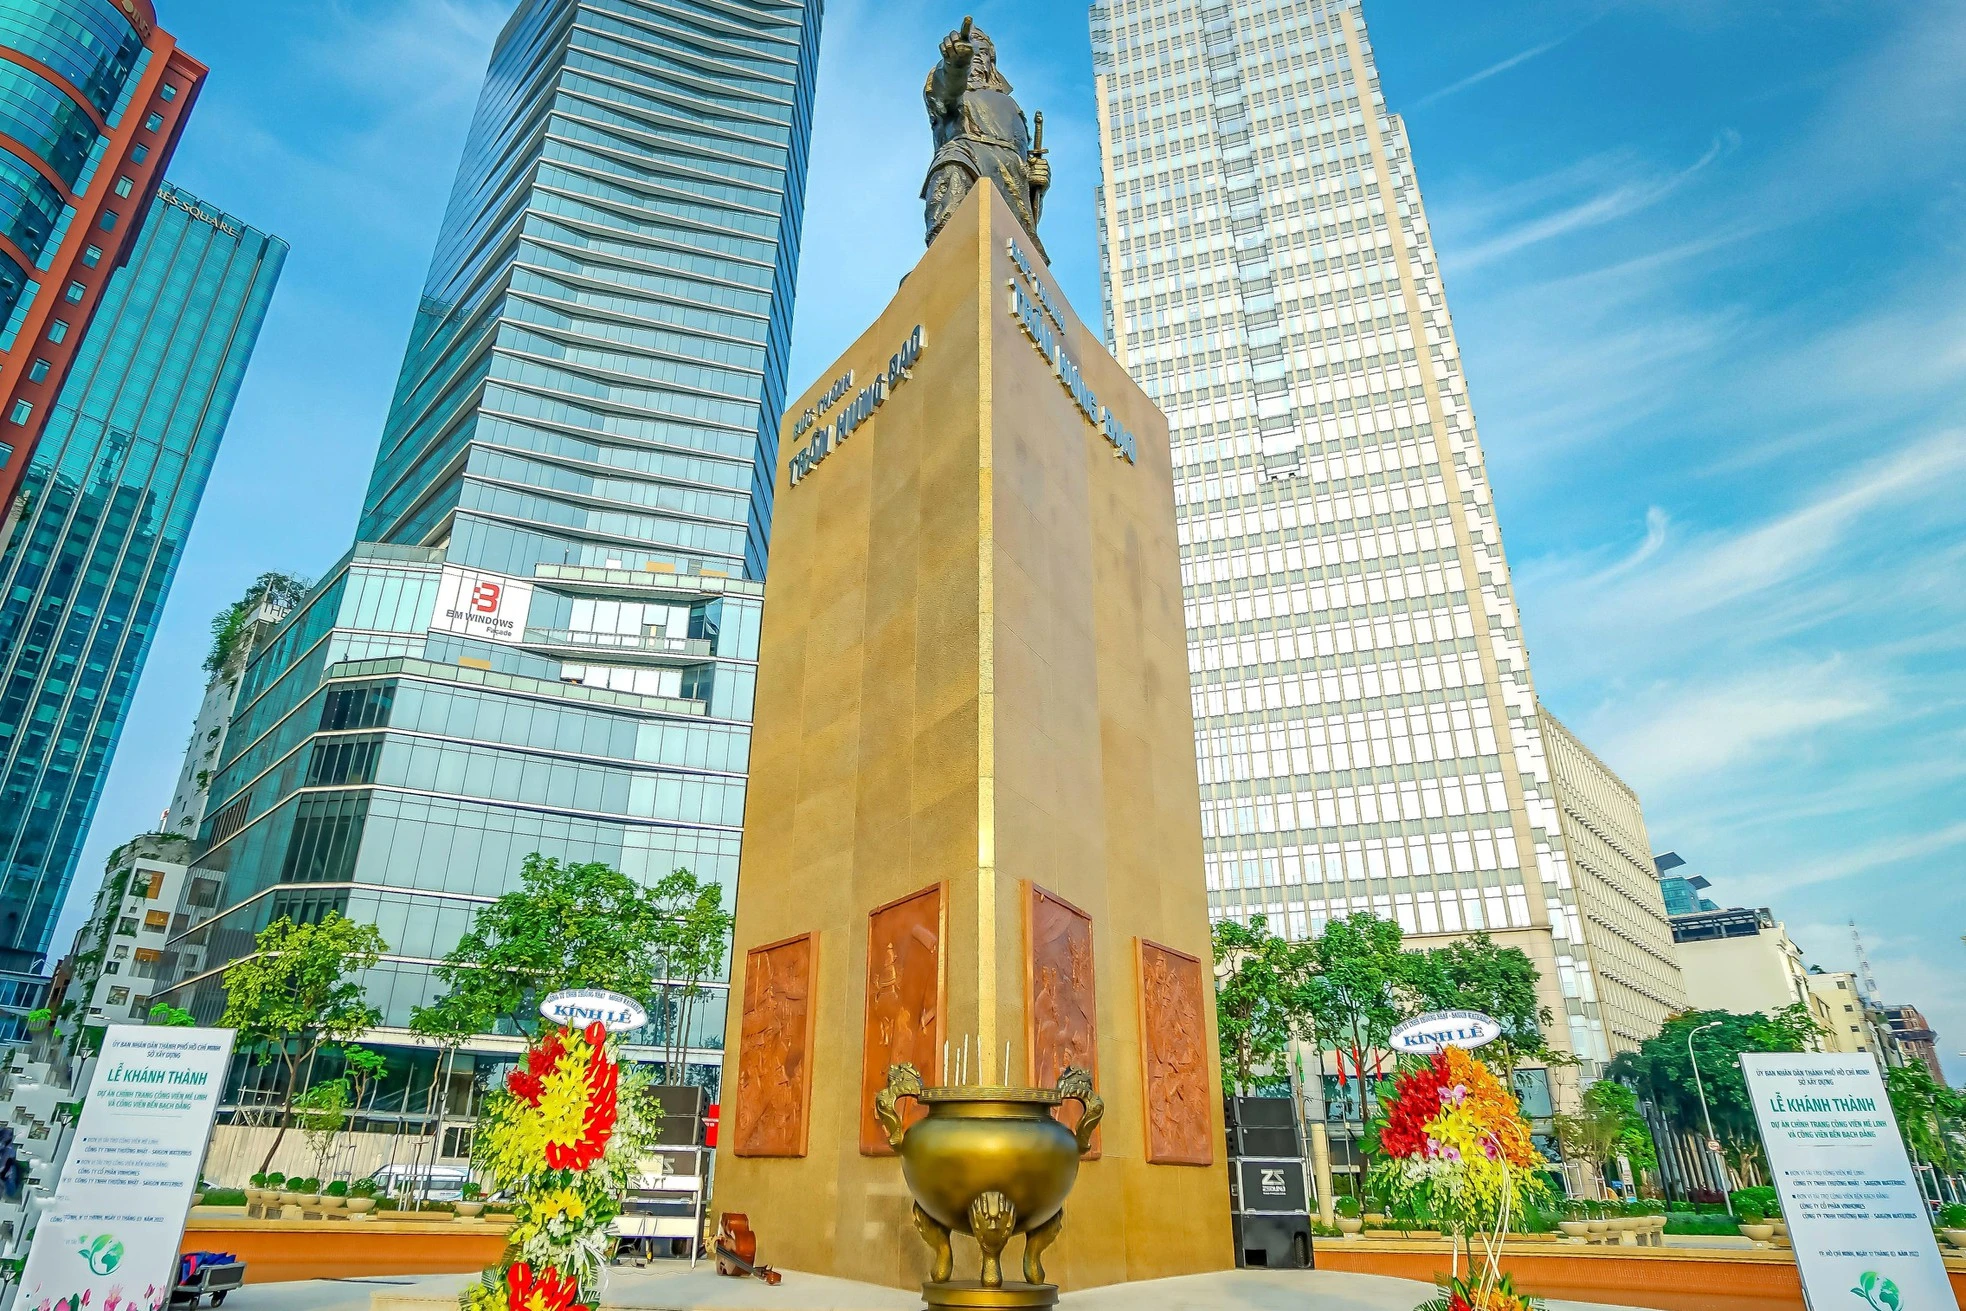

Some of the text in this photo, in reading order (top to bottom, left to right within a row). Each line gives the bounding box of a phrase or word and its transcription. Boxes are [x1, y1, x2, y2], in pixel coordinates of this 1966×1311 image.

[181, 201, 240, 238] SQUARE
[465, 612, 514, 629] WINDOWS
[553, 1003, 632, 1024] KÍNH LỄ
[1403, 1022, 1485, 1047] KÍNH LỄ
[107, 1062, 208, 1085] LỄ KHÁNH THÀNH
[1770, 1092, 1876, 1112] LỄ KHÁNH THÀNH
